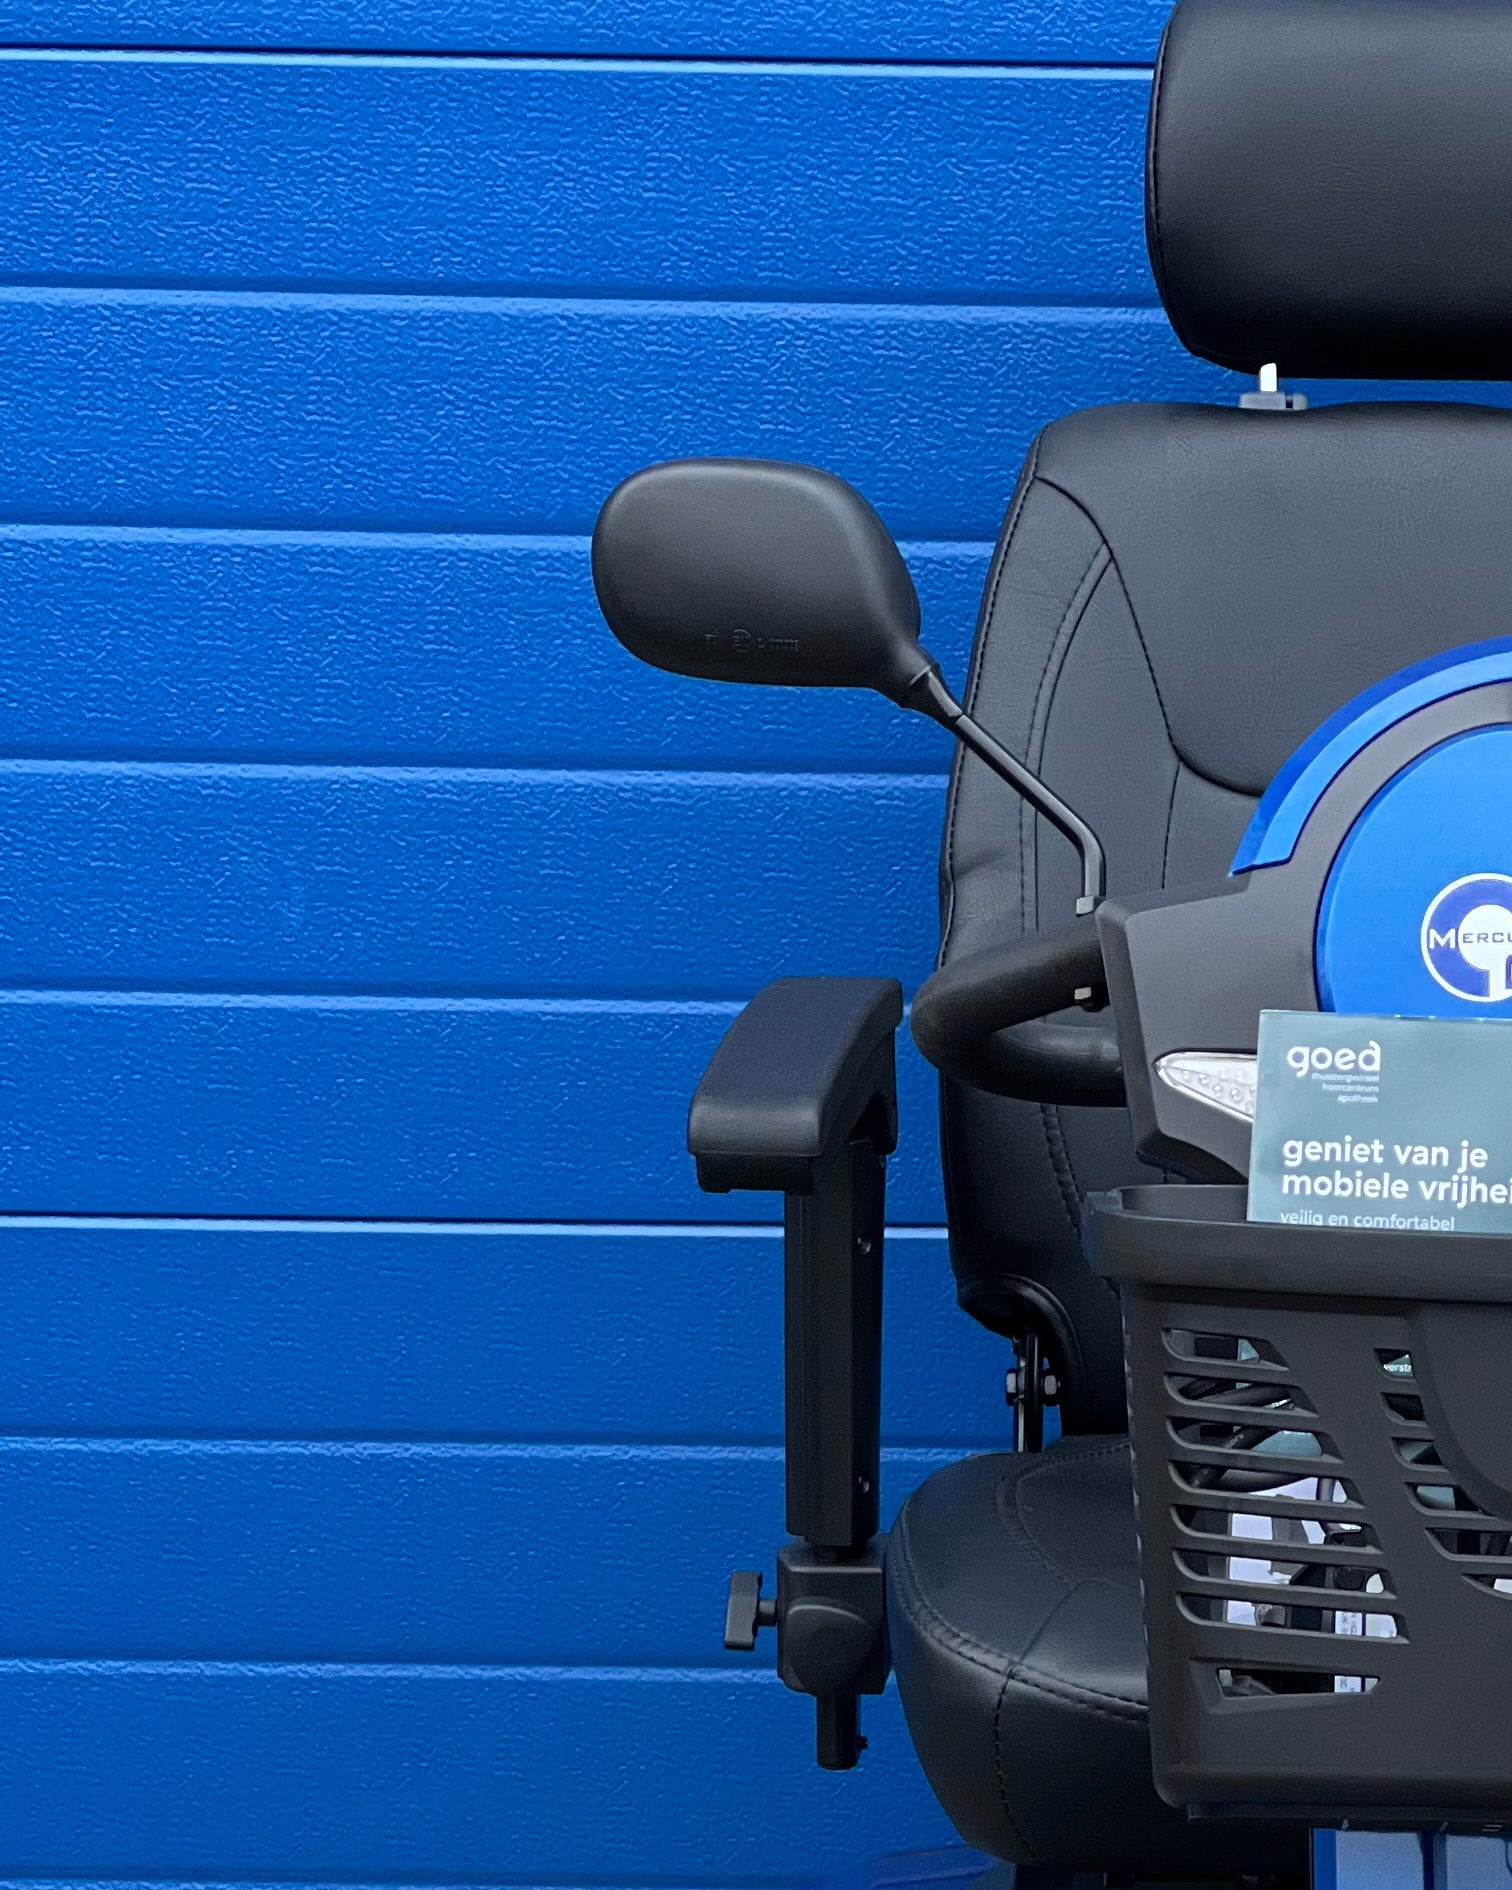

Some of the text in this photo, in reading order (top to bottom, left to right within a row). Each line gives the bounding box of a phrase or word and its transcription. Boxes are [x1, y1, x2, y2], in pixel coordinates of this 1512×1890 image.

[1286, 1040, 1381, 1078] goed
[1283, 1135, 1489, 1174] geniet van je
[1282, 1170, 1410, 1199] mobiele
[1280, 1209, 1456, 1232] veilig en comfortabel
